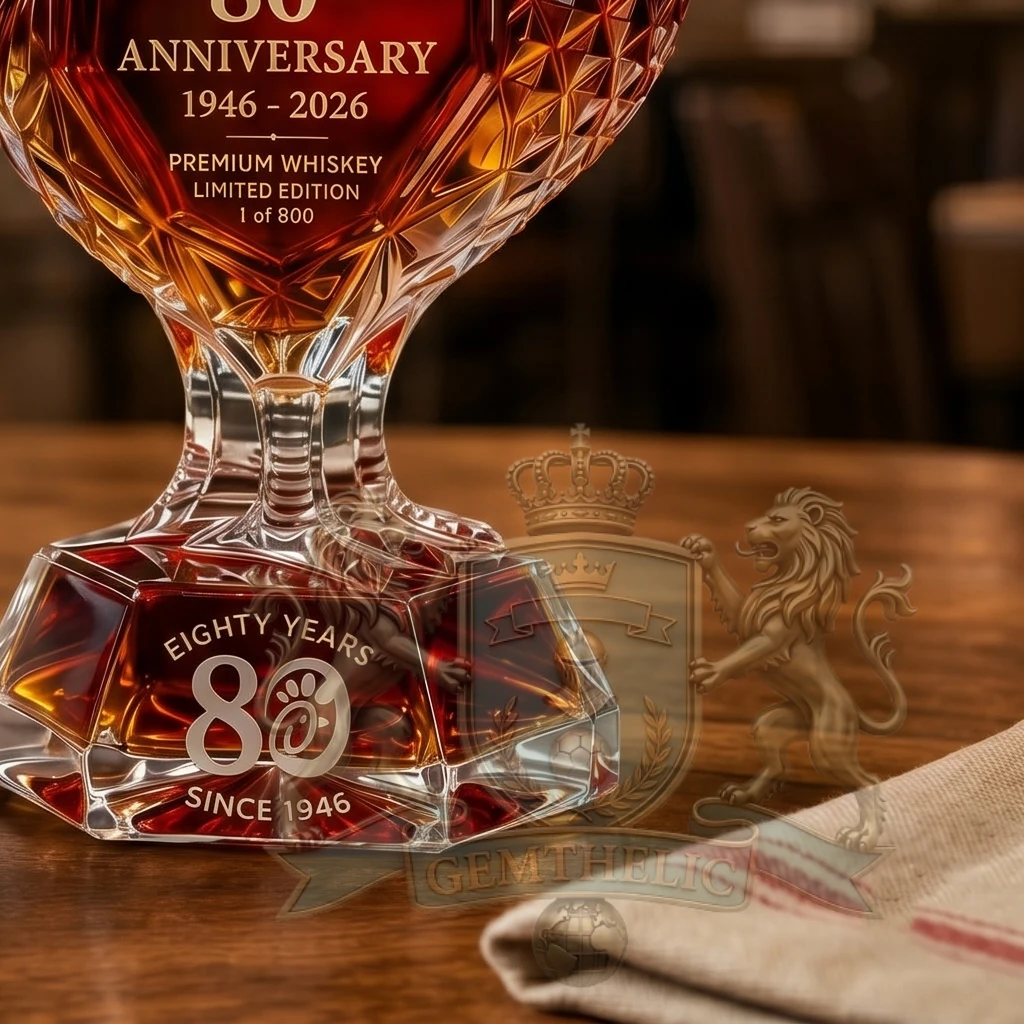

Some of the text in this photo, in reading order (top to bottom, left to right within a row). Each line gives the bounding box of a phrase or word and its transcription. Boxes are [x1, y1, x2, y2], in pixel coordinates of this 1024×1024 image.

[116, 38, 438, 75] ANNIVERSARY
[181, 89, 258, 119] 1946
[288, 91, 369, 120] 2026
[169, 153, 383, 175] PREMIUM WHISKEY
[193, 182, 360, 201] LIMITED EDITION
[239, 206, 315, 225] 1 of 800
[163, 612, 375, 666] EIGHTY YEARS
[184, 786, 352, 822] SINCE 1946
